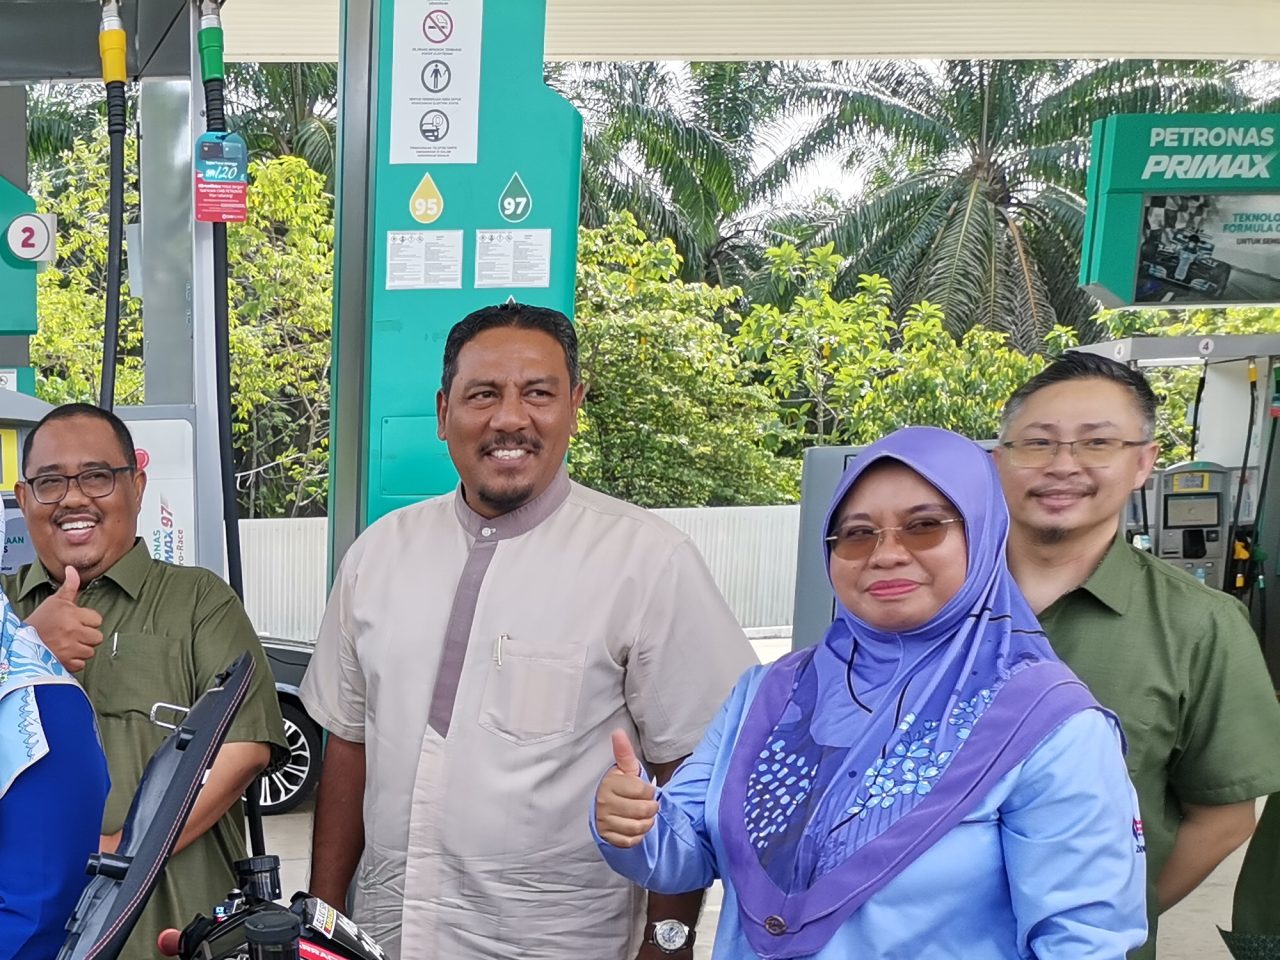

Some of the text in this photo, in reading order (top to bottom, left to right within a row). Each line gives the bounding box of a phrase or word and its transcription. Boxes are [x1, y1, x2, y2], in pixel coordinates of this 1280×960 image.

[1150, 127, 1274, 147] PETRONAS
[1141, 152, 1279, 180] PRIMAX
[415, 198, 438, 215] 95
[503, 197, 527, 215] 97
[21, 227, 36, 247] 2
[1223, 224, 1274, 233] FORMULA
[1116, 346, 1122, 356] 4
[1203, 341, 1210, 351] 4
[160, 504, 174, 528] 97
